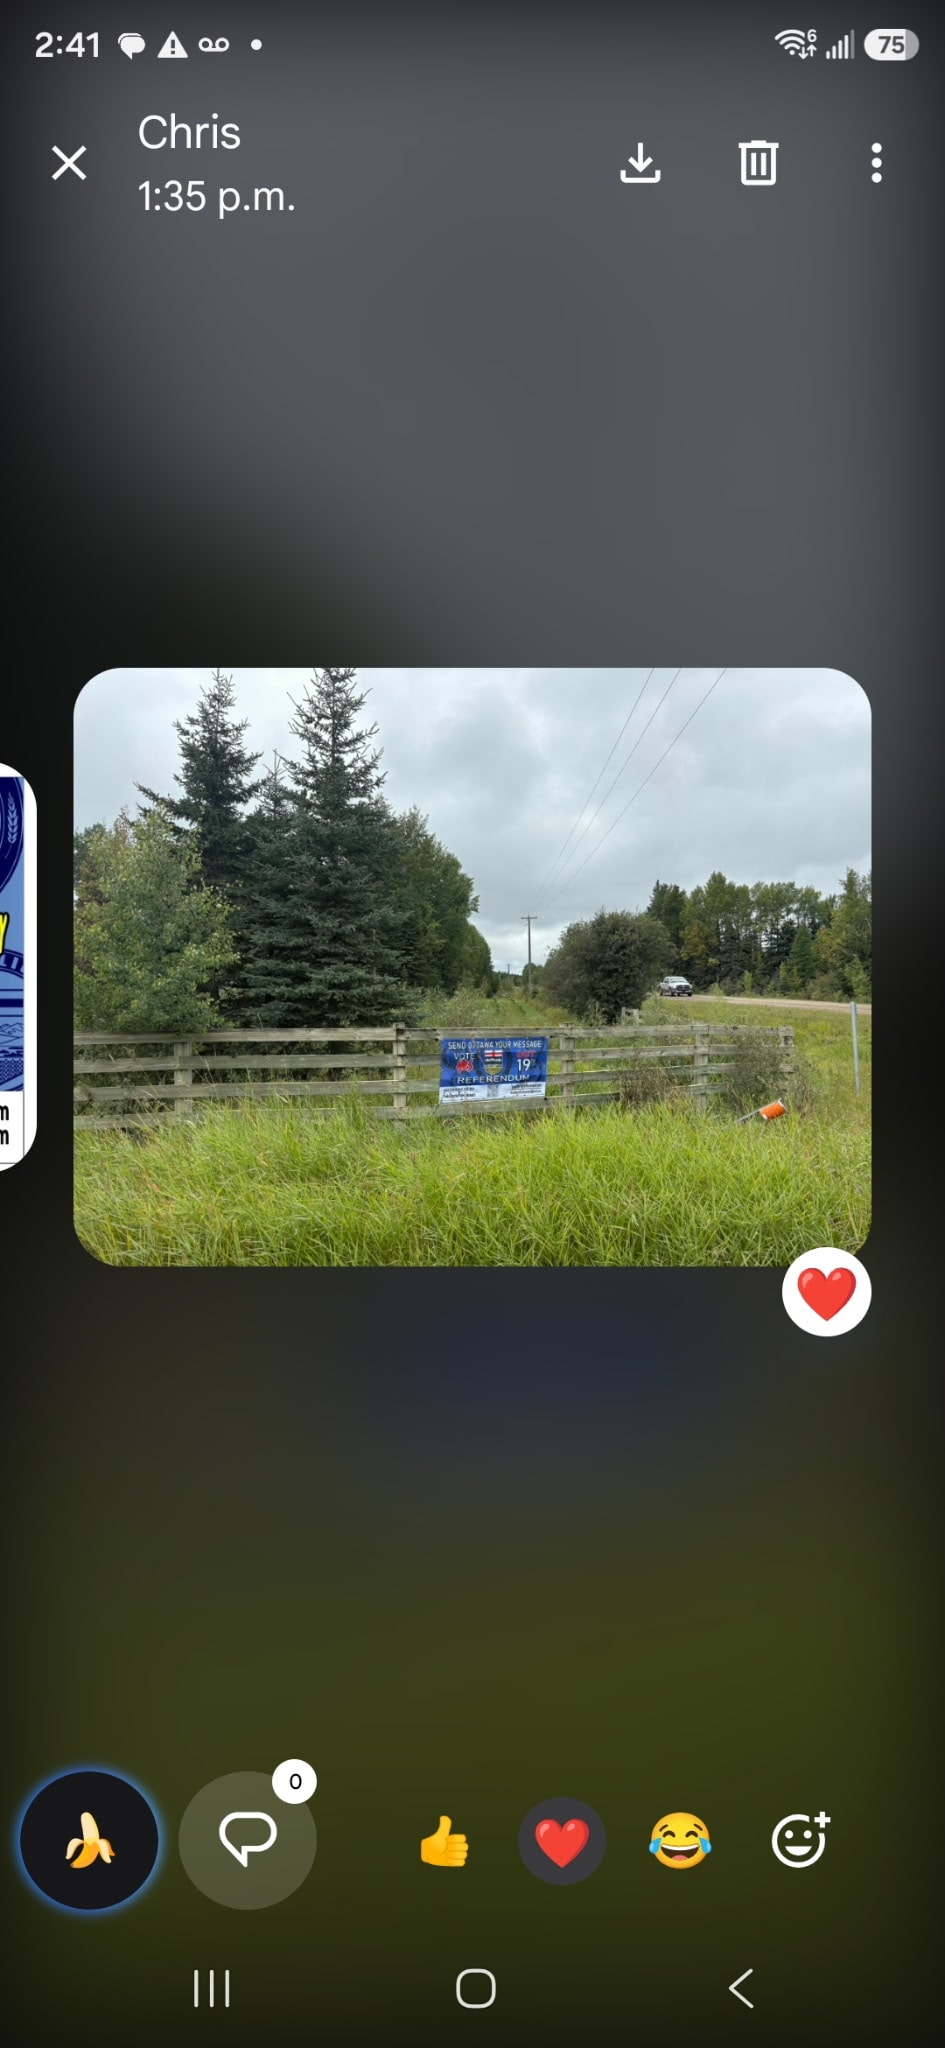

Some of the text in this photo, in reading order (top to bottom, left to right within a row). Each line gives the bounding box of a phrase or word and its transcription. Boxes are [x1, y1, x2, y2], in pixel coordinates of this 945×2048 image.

[35, 31, 99, 58] 2:41
[878, 36, 905, 54] 75
[138, 113, 241, 150] Chris
[138, 179, 295, 219] 1:35 p.m.
[448, 1040, 542, 1050] SEND OTTAWA YOUR MESSAGE
[454, 1052, 476, 1060] VOTE
[457, 1074, 530, 1084] REFERENDUM
[290, 1773, 302, 1790] 0
